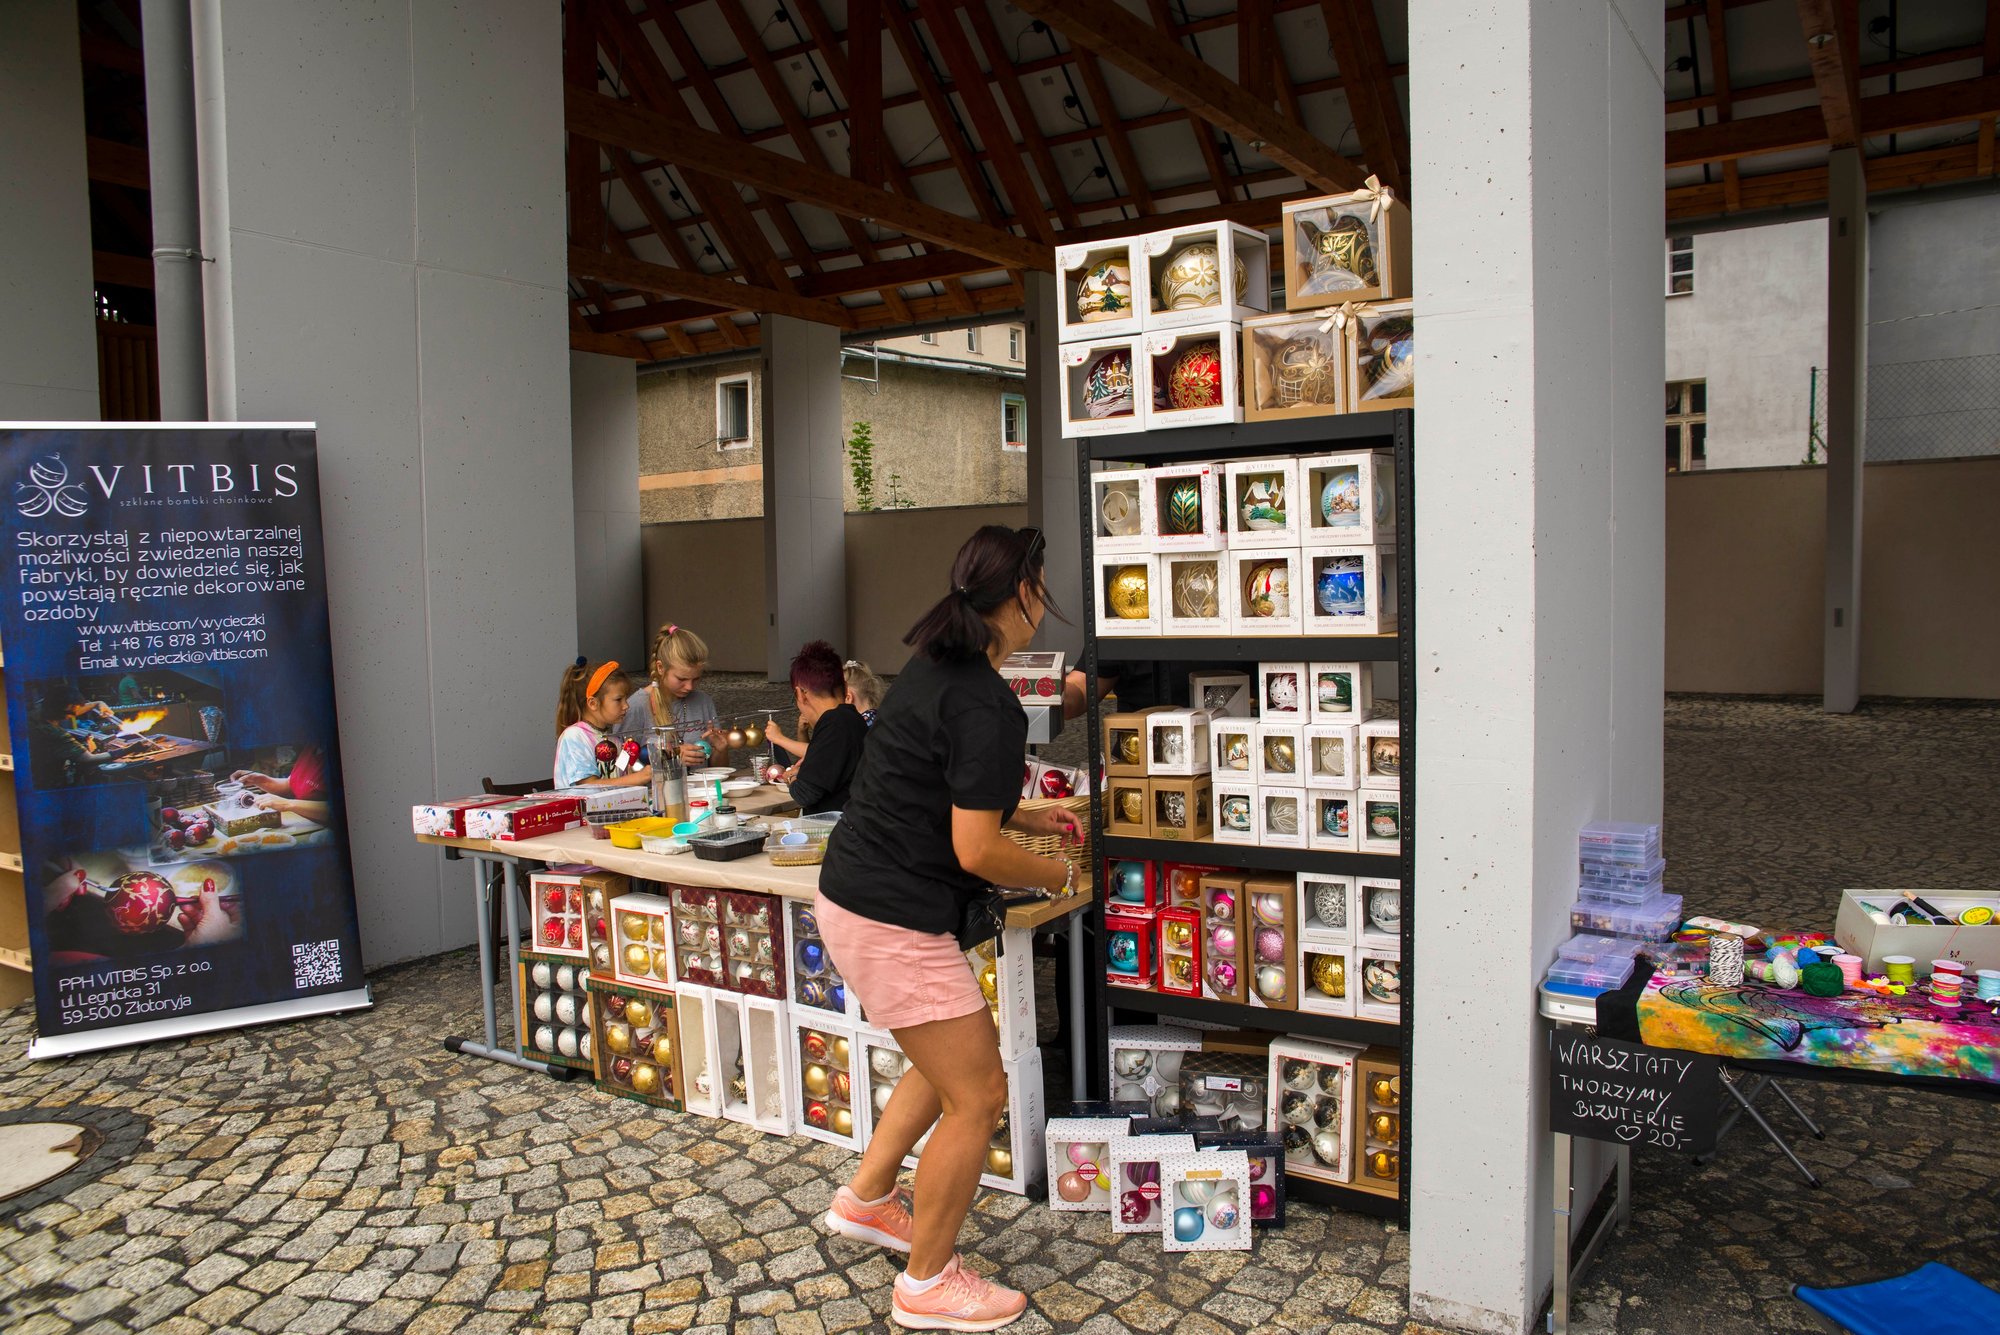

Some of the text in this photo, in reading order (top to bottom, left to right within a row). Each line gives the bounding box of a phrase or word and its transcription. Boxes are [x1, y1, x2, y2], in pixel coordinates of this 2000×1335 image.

[88, 463, 298, 500] VITBIS
[120, 495, 273, 507] szklane bombki choinkowe
[17, 524, 301, 549] Skorzystaj z niepowtarzalnej
[19, 542, 303, 566] możliwości zwiedzenia naszej
[20, 559, 304, 586] fabryki, by dowiedzieć się, jak
[22, 579, 305, 606] powstają ręcznie dekorowane
[24, 604, 99, 622] ozdoby
[77, 613, 266, 636] www.vitbis.com/wycieczki
[109, 637, 141, 651] +48
[145, 635, 164, 648] 76
[169, 634, 196, 647] 878
[200, 632, 215, 645] 31
[219, 629, 267, 644] 10/410
[122, 648, 268, 669] wycieczki@vitbis.com
[59, 974, 95, 993] PPH
[97, 967, 148, 986] VITBIS
[150, 964, 174, 980] Sp.
[176, 964, 187, 975] z
[1017, 953, 1025, 1004] VITBIS
[78, 986, 142, 1006] Legnicka
[145, 981, 161, 996] 31
[62, 993, 192, 1025] 59-500 Złotoryja
[1558, 1038, 1694, 1084] WARSZTATY
[1558, 1074, 1673, 1115] TWORZYMY
